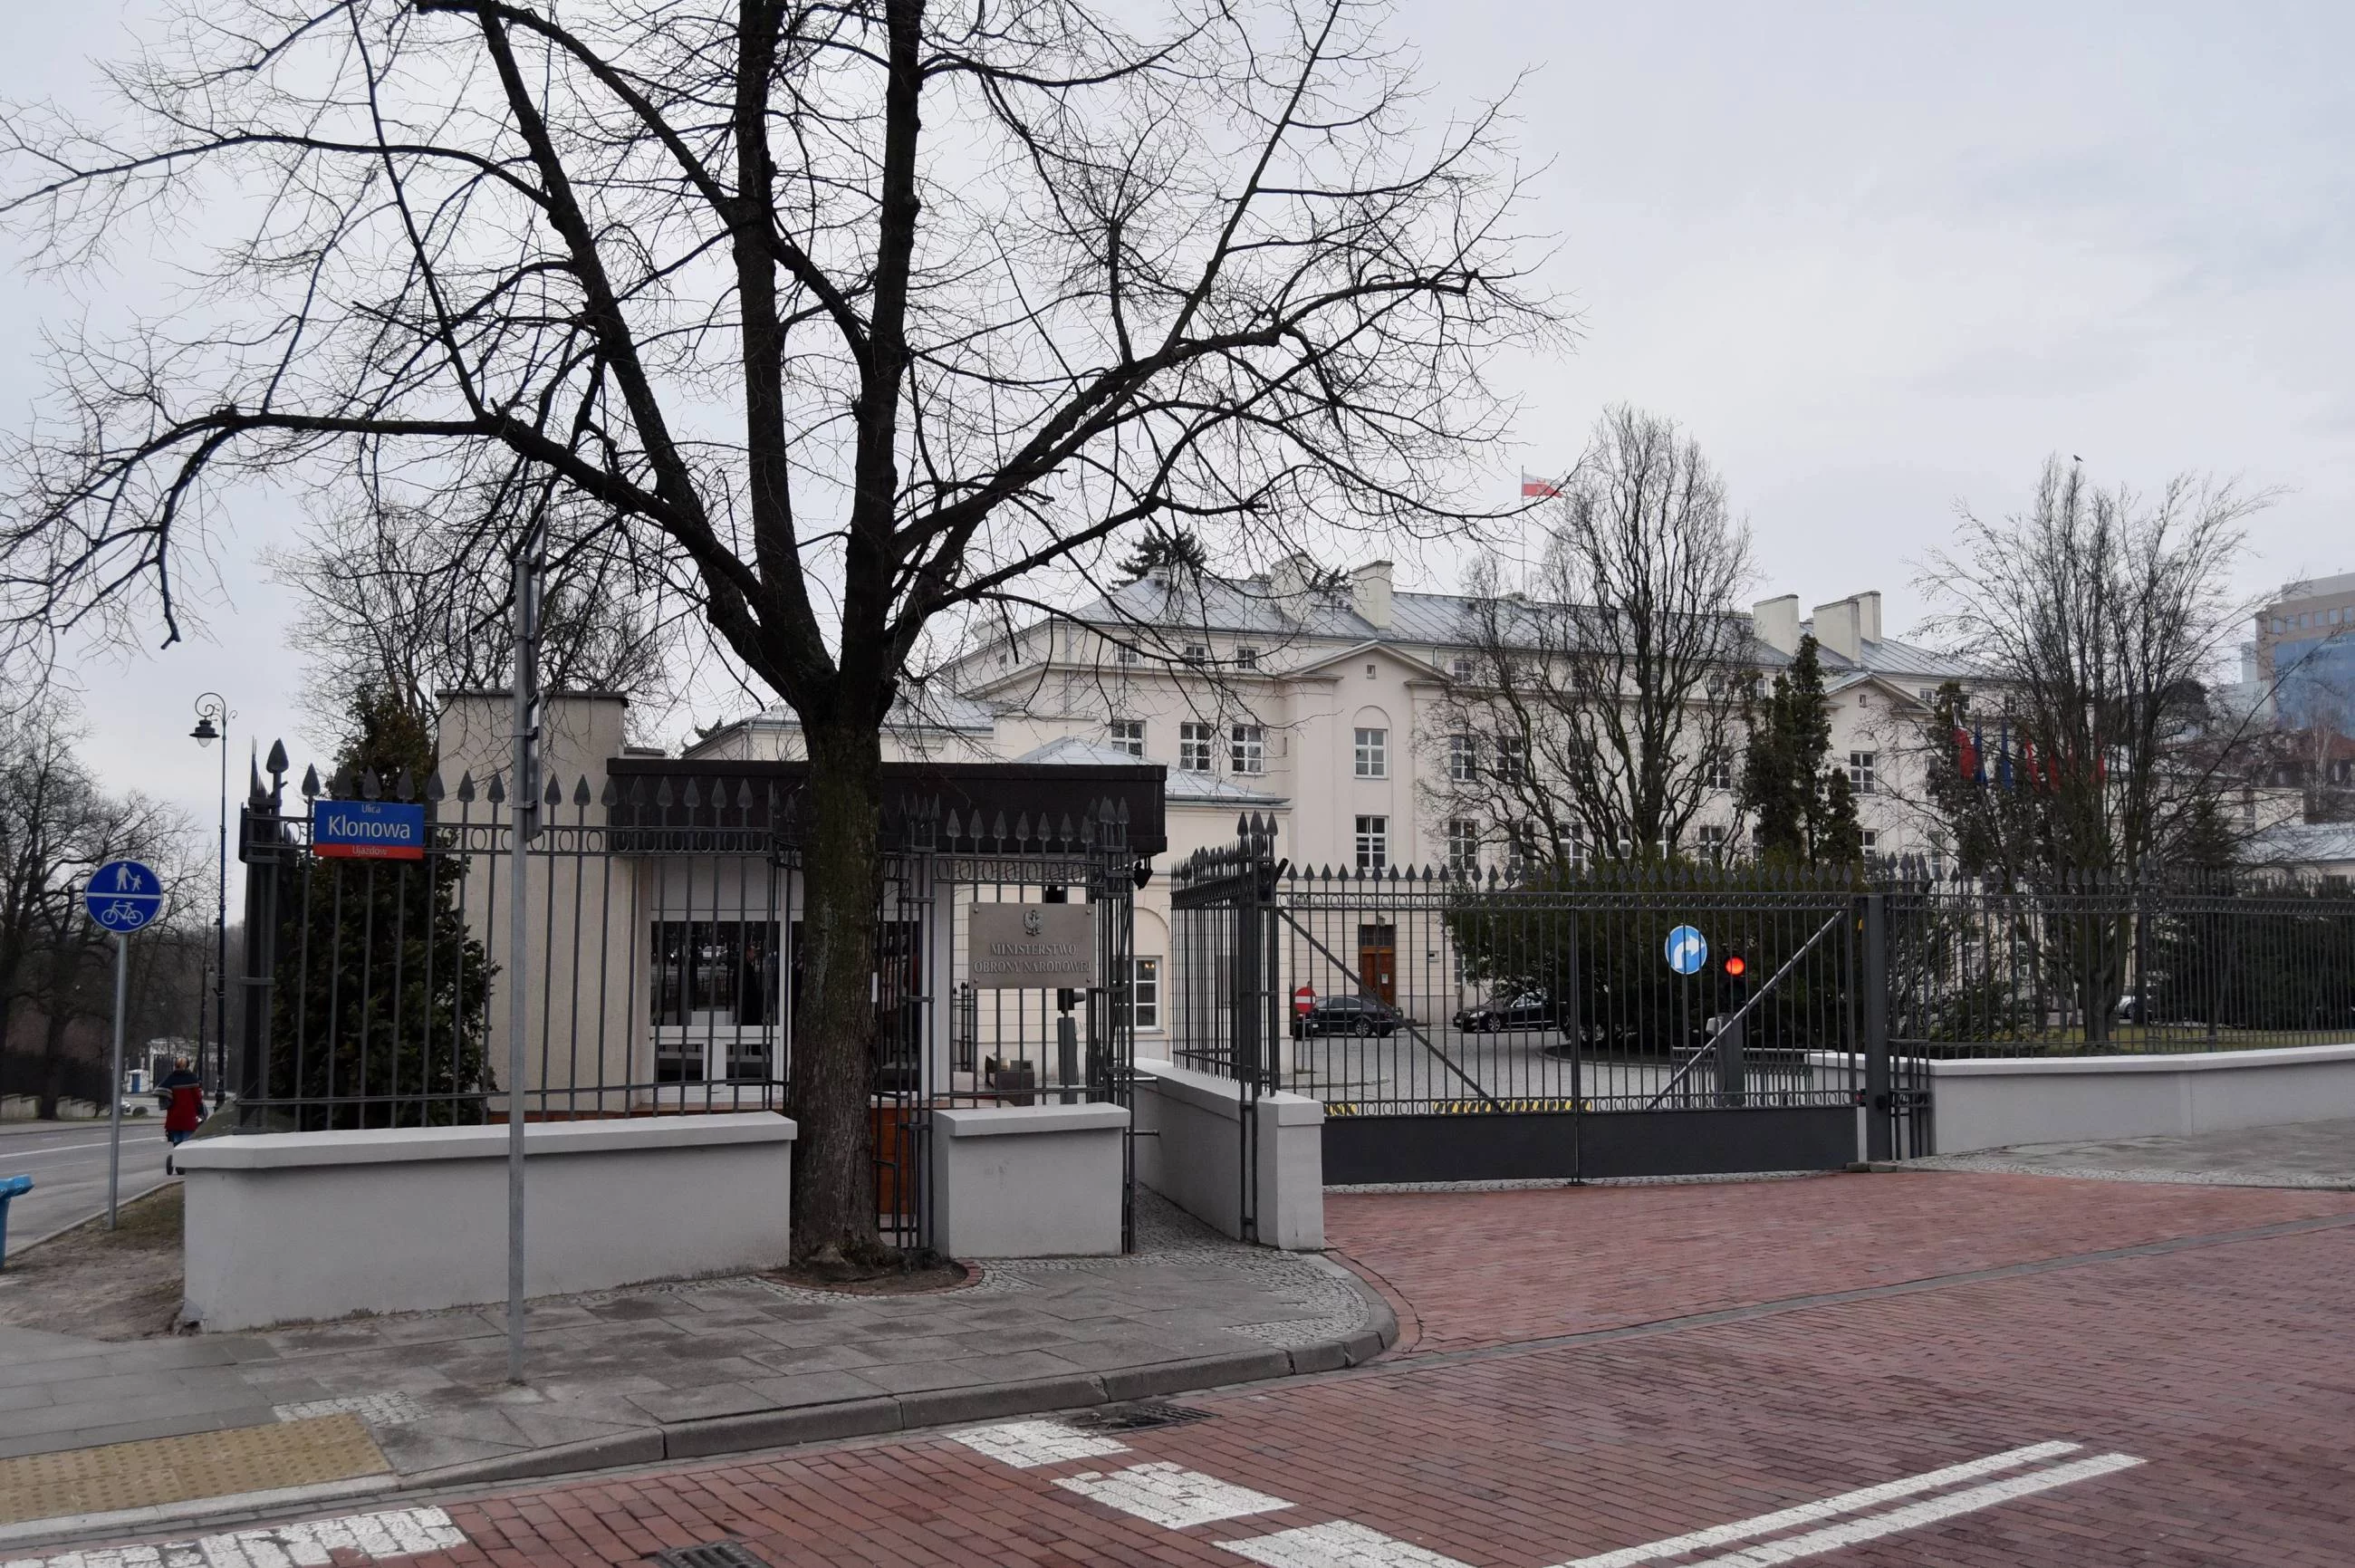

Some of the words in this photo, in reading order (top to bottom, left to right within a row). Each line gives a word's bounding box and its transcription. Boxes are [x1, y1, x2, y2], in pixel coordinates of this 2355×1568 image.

[361, 803, 380, 813] Ulica
[328, 815, 410, 839] Klonowa
[990, 942, 1077, 957] MINISTERSTWO
[974, 960, 1020, 974] OBRONY
[1023, 960, 1091, 974] NARODOWEJ
